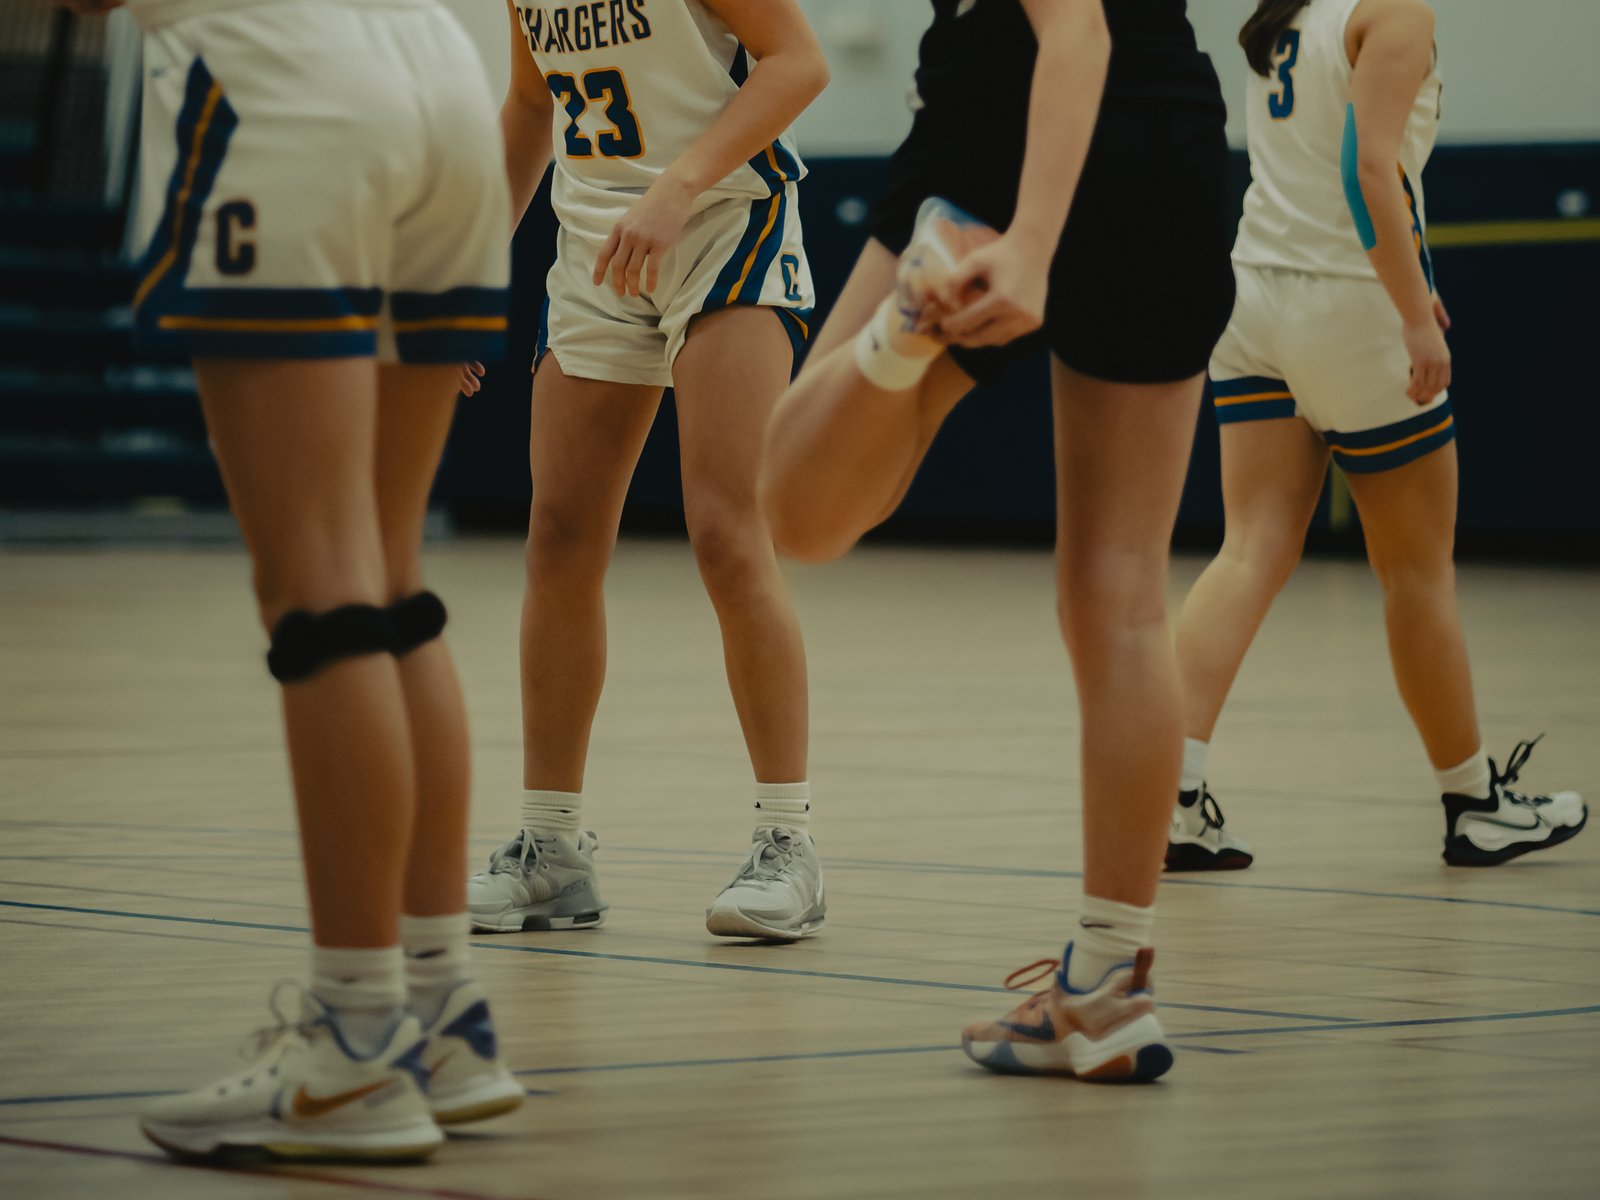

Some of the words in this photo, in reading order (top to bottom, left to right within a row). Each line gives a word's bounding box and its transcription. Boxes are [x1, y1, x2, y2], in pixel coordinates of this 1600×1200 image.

[546, 67, 645, 159] 23
[1267, 29, 1300, 121] 3
[215, 200, 256, 276] C
